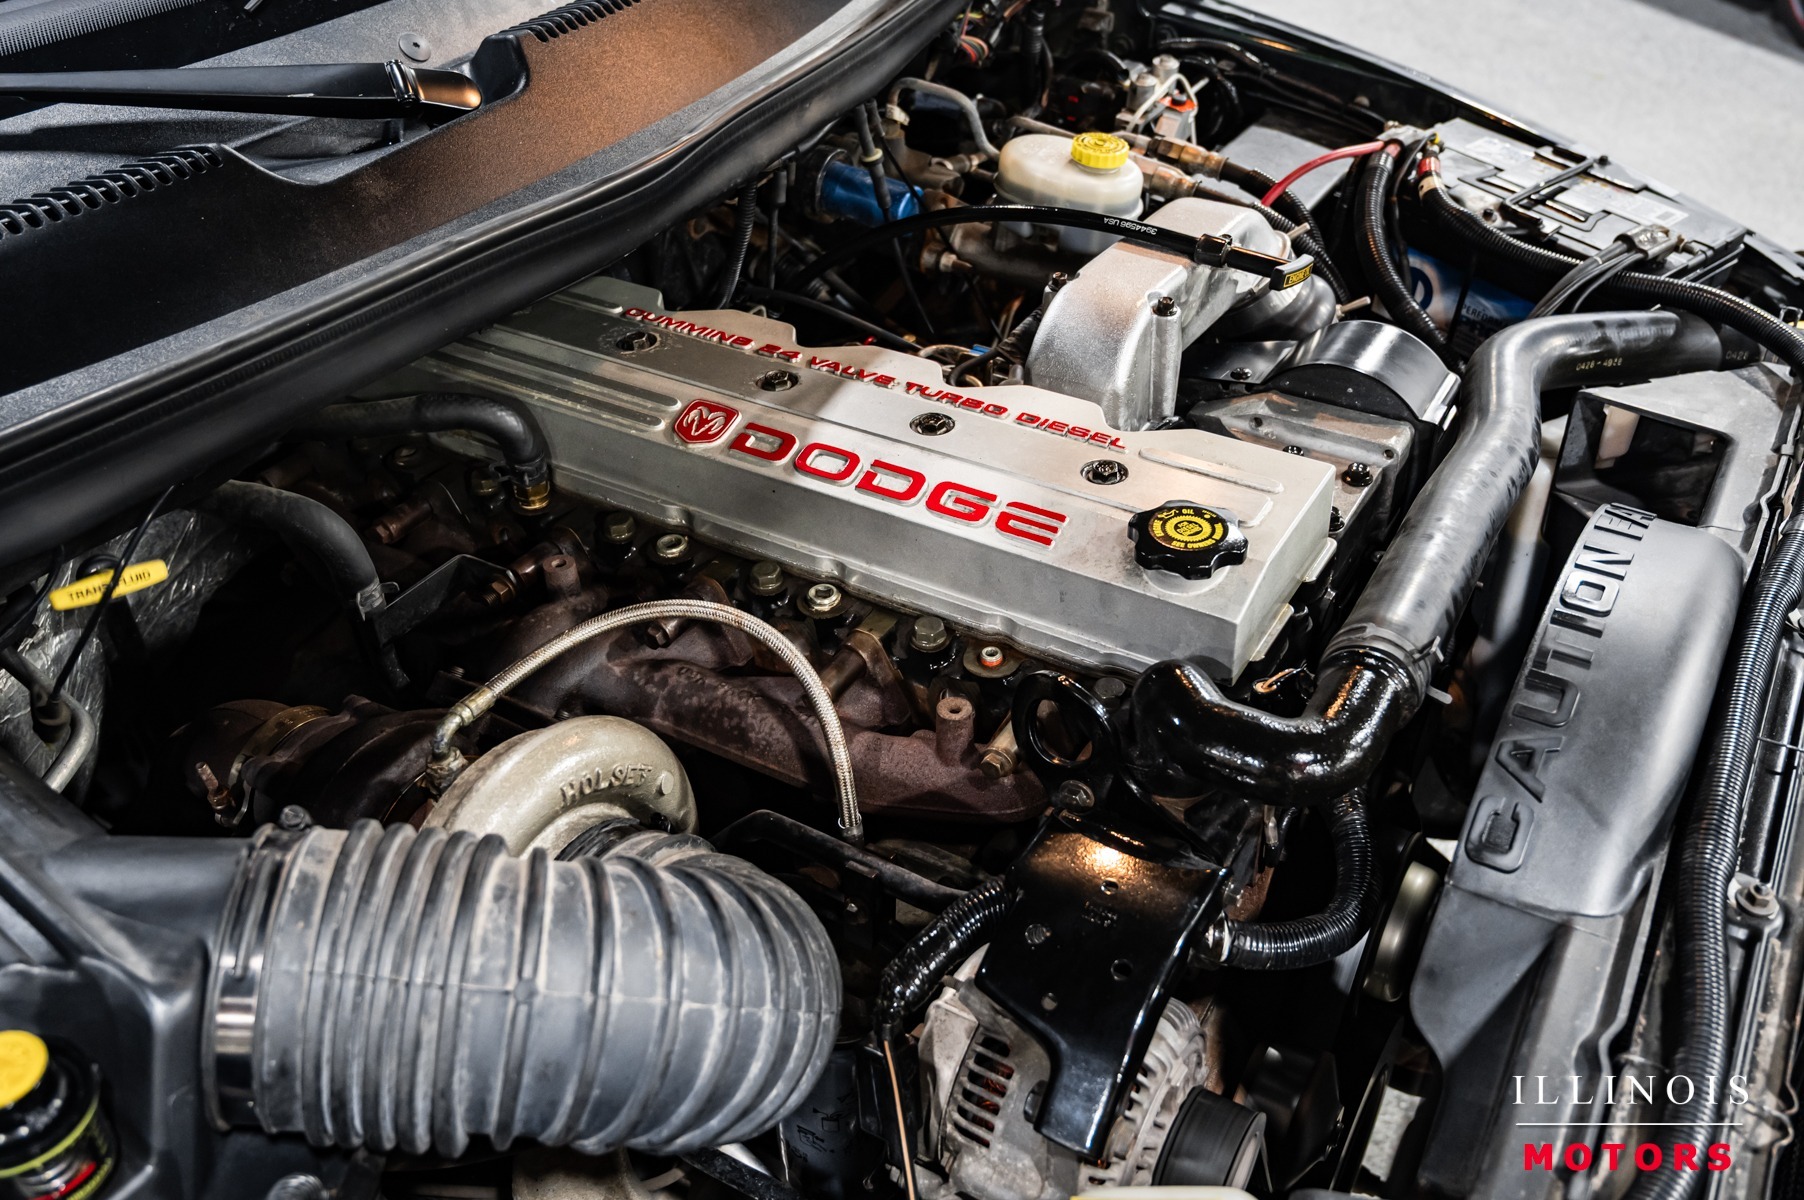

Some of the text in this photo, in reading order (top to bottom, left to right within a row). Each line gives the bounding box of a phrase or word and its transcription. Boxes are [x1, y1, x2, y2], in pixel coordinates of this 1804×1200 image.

[1104, 217, 1120, 227] USA
[625, 308, 1129, 454] CUMMINS 24 VALVE TURBO DIESEL
[728, 422, 1069, 548] DODGE
[117, 569, 151, 587] LUID
[1464, 503, 1657, 874] CAUTION FA
[559, 763, 654, 808] HOLSET
